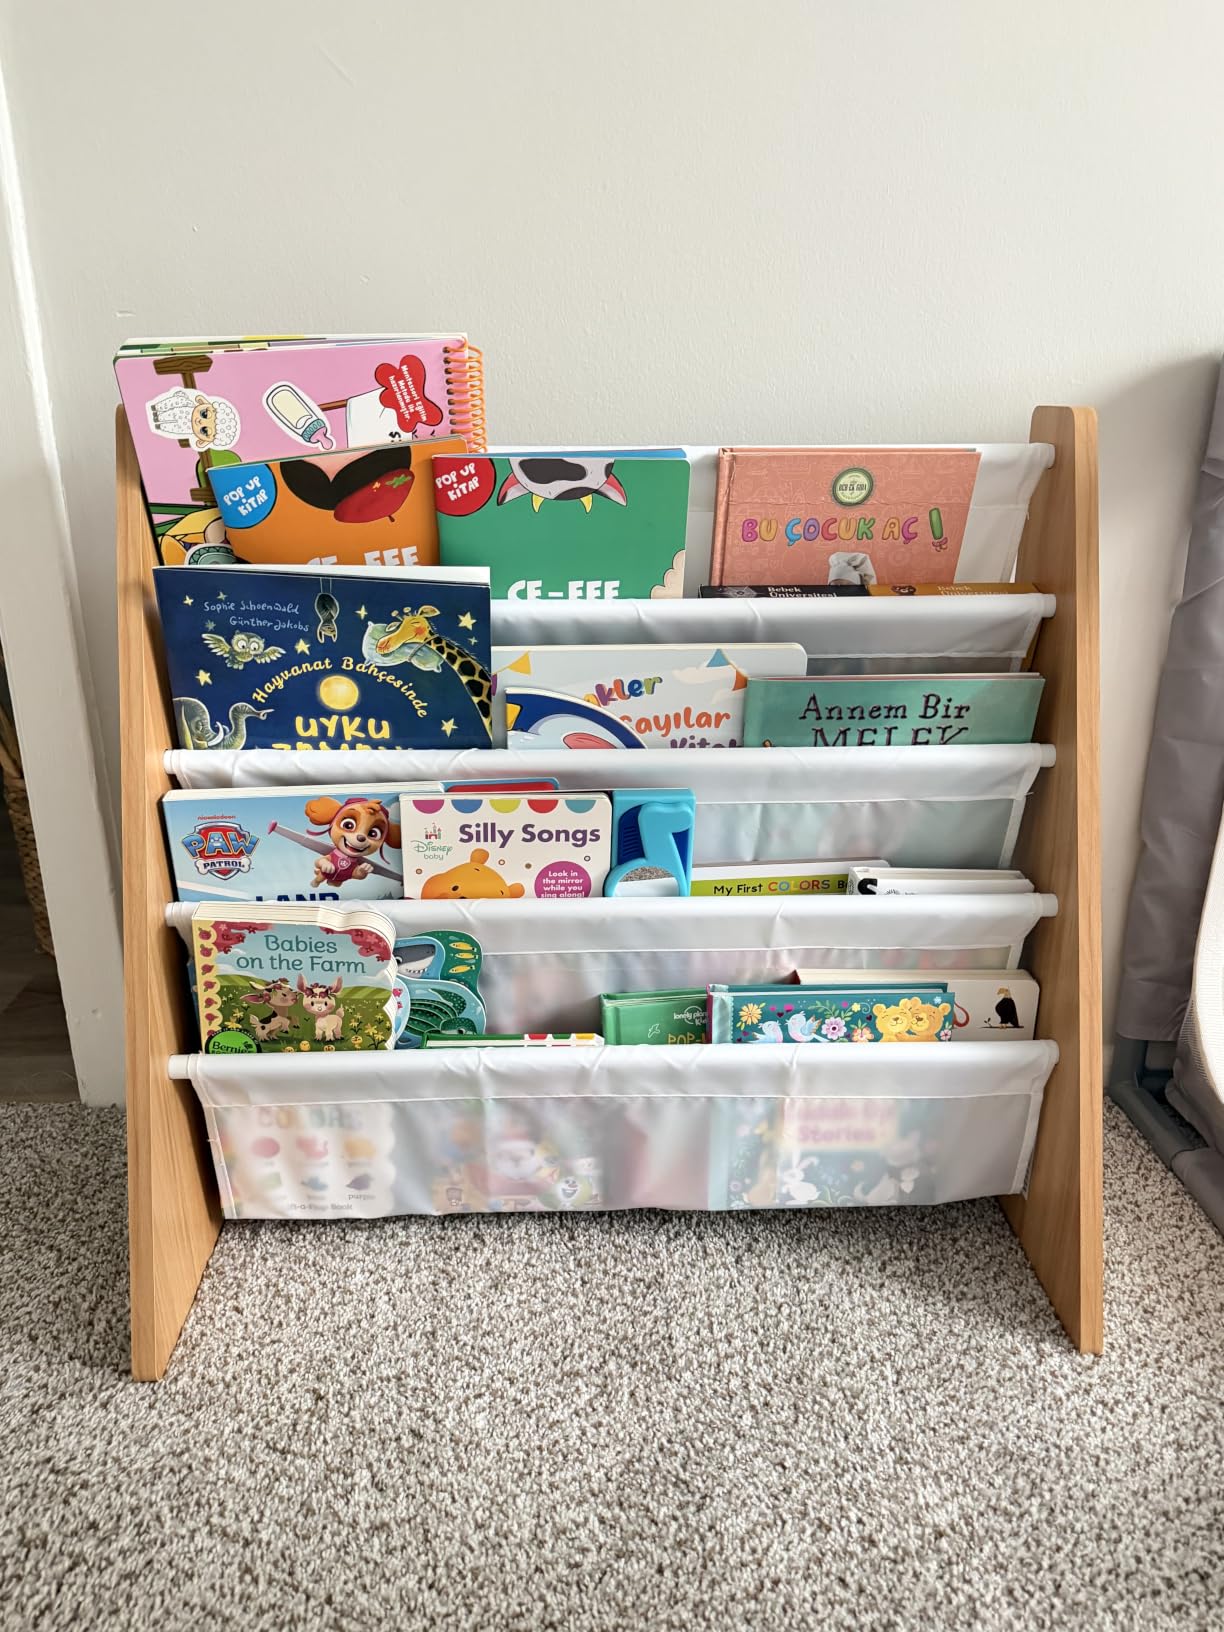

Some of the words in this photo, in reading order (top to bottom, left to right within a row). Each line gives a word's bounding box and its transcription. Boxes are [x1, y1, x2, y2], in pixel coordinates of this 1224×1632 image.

[435, 470, 457, 489] POP
[459, 462, 476, 476] UP
[223, 486, 245, 506] POP
[245, 475, 262, 491] UP
[447, 476, 480, 501] KİTAP
[237, 488, 269, 516] KİTAP
[741, 517, 778, 542] BU
[785, 517, 876, 546] ÇOCUK
[881, 516, 918, 544] AÇ
[204, 601, 235, 613] Sophie
[240, 600, 300, 614] Schoenwald
[229, 616, 273, 627] Günther
[273, 620, 310, 632] Jakobs
[252, 657, 333, 703] Hayvanat
[341, 656, 429, 718] Bahçesinde
[798, 692, 908, 721] Annem
[918, 693, 971, 720] Bir
[295, 715, 391, 740] UYKU
[181, 832, 259, 858] PAW
[458, 822, 515, 848] Silly
[521, 824, 601, 848] Songs
[203, 860, 245, 869] PATROL
[713, 885, 733, 896] My
[736, 883, 763, 894] First
[767, 879, 830, 892] COLORS
[264, 934, 338, 953] Babies
[236, 956, 264, 970] on
[270, 953, 303, 971] the
[310, 955, 366, 974] Farm
[673, 1011, 693, 1020] lonely
